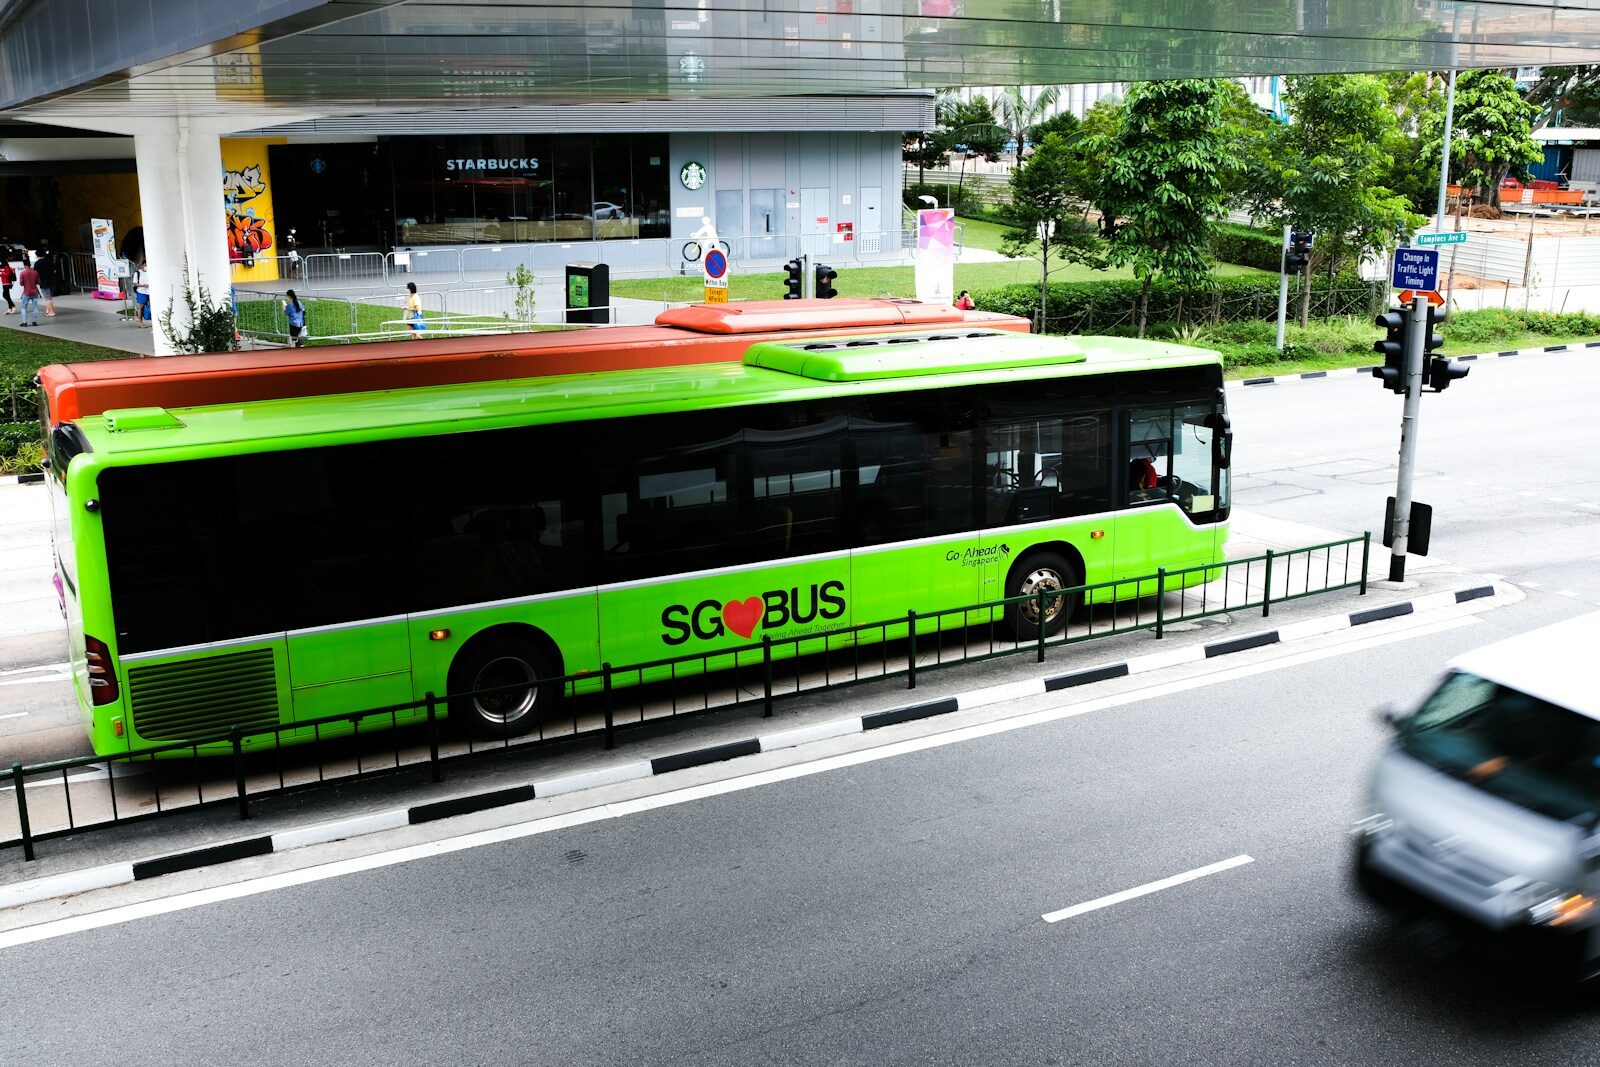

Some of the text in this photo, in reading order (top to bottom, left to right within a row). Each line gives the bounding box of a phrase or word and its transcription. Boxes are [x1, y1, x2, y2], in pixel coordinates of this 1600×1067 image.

[446, 158, 539, 170] STARBUCKS
[1420, 235, 1446, 244] Tampines
[1403, 253, 1430, 264] Change In
[1398, 264, 1434, 276] Traffic Light
[1405, 276, 1424, 288] Timing
[946, 544, 998, 561] Go-Ahead
[962, 556, 998, 567] Singapore
[759, 621, 845, 641] Mving Ahead Together
